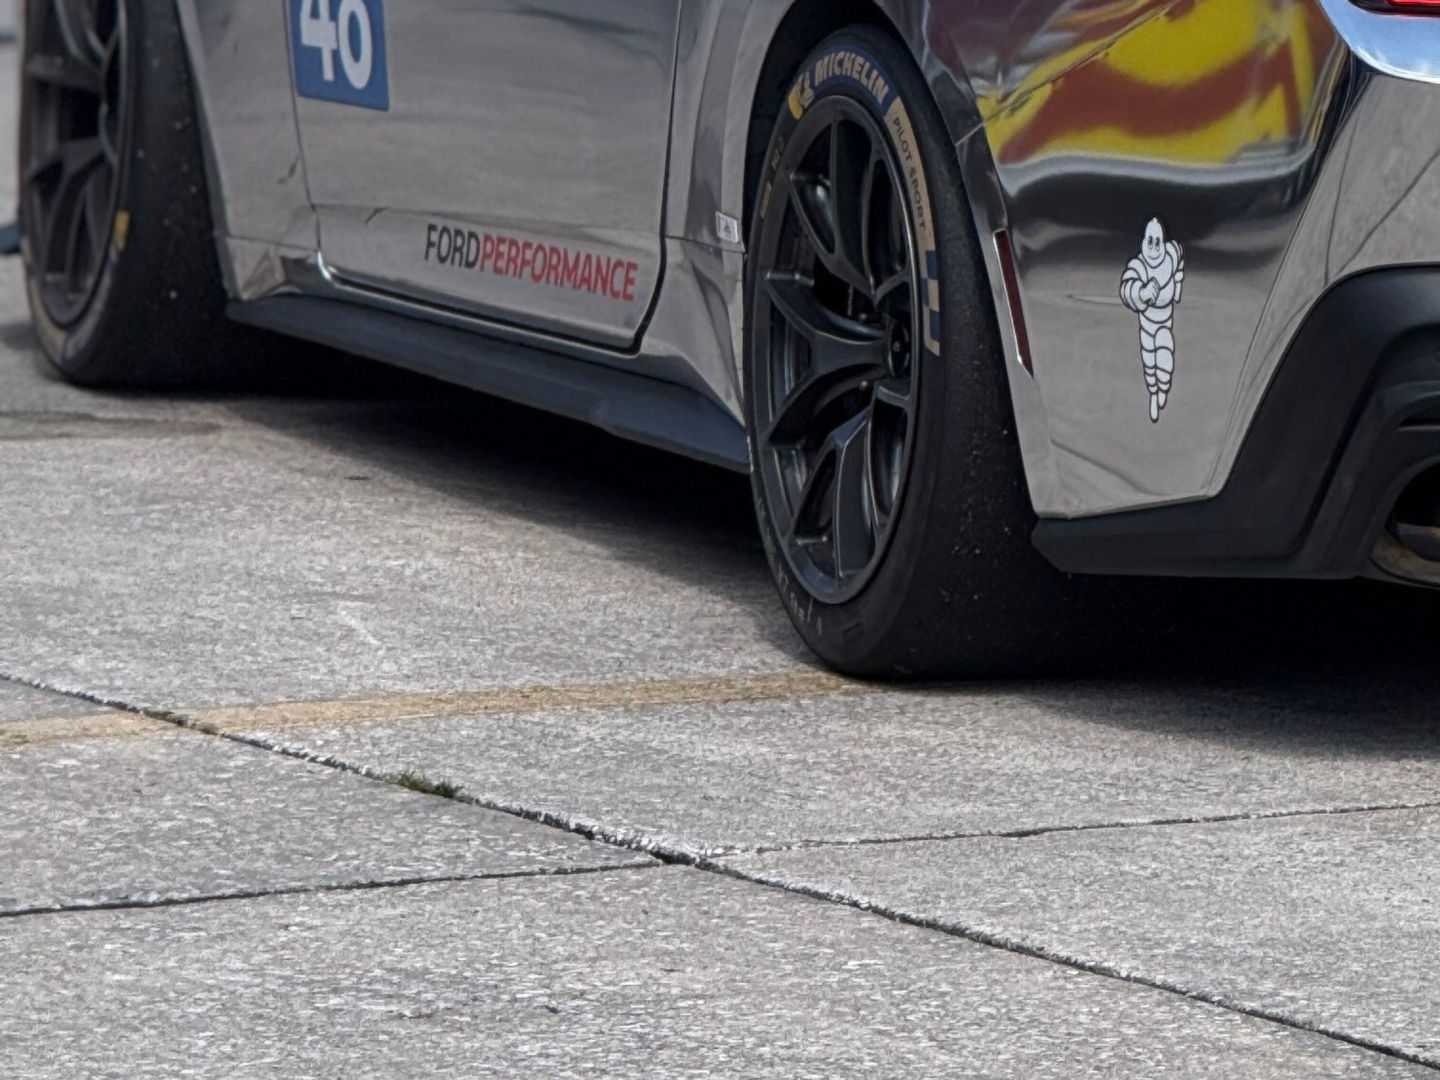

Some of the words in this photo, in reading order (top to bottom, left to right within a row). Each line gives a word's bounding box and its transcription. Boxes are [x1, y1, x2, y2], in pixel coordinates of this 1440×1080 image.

[815, 51, 889, 104] MICHELIN
[893, 117, 912, 160] PILOT
[909, 167, 926, 231] SPORT
